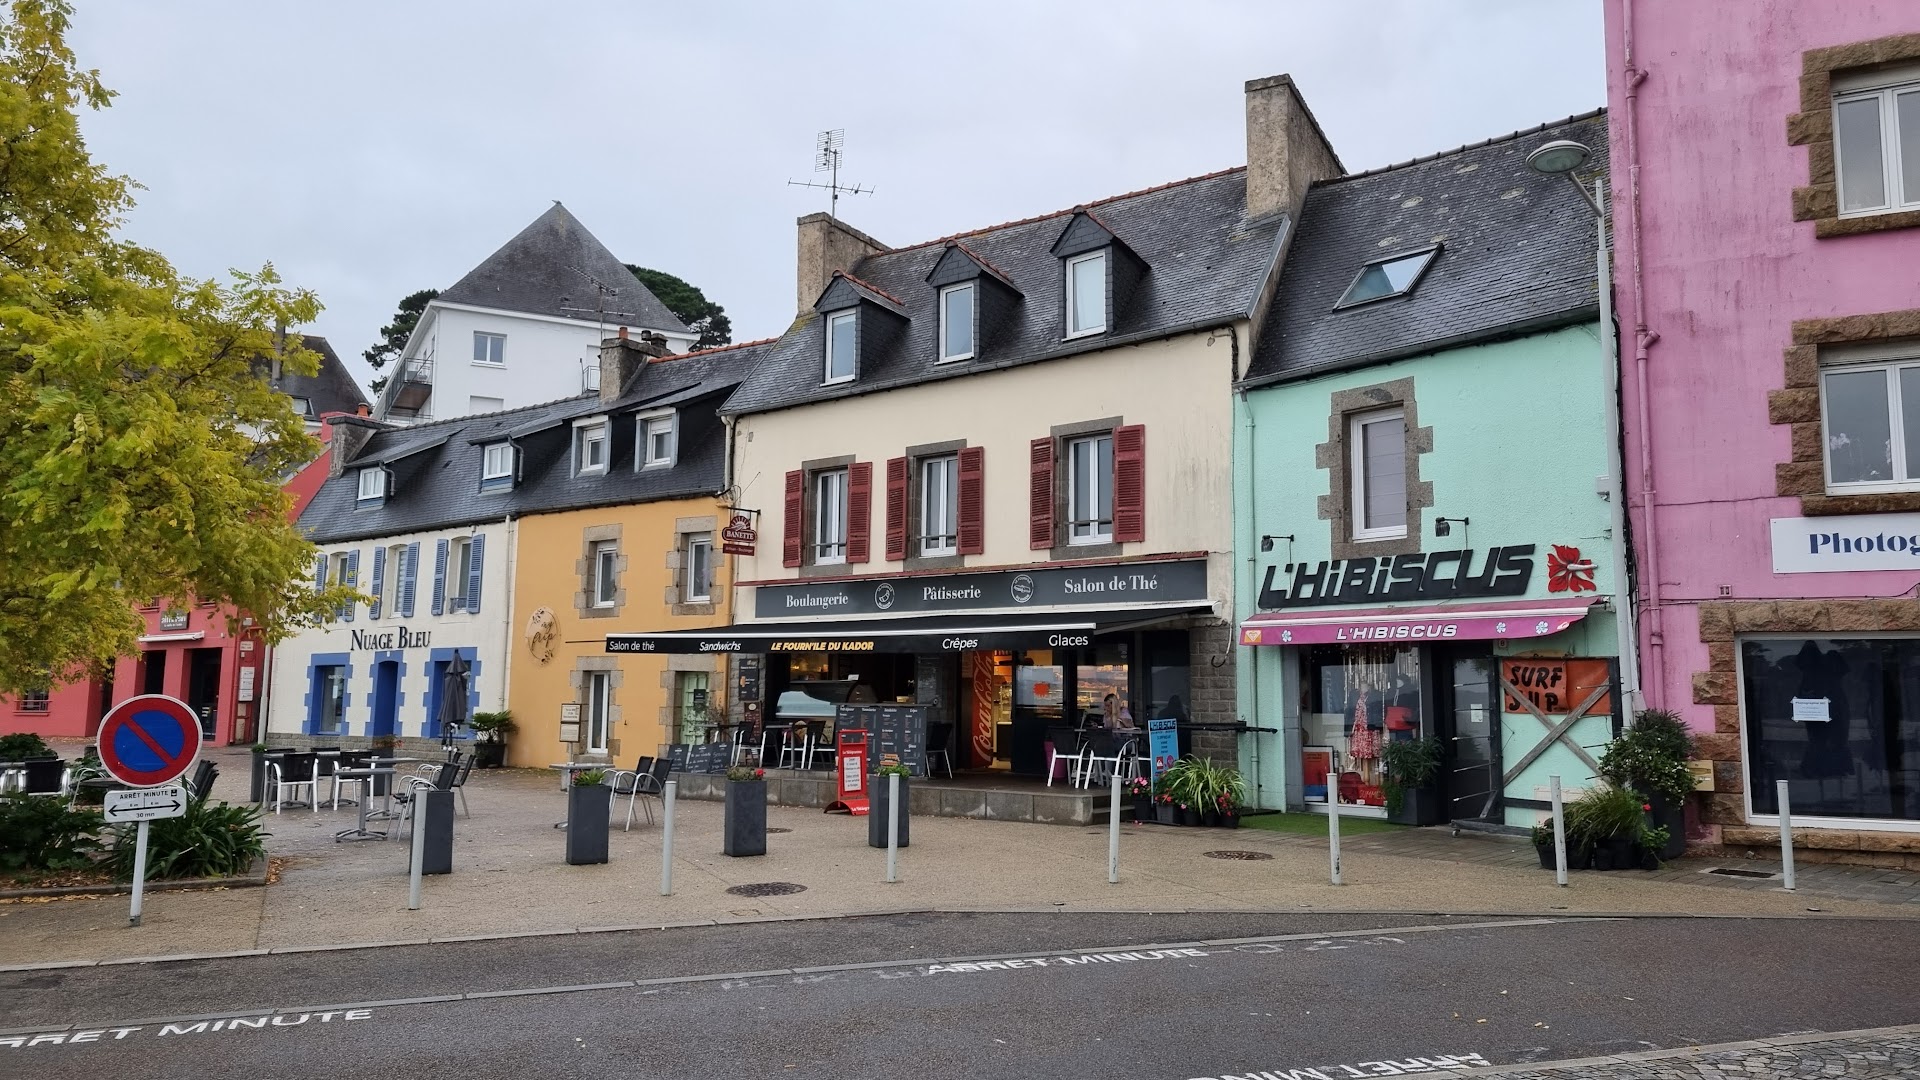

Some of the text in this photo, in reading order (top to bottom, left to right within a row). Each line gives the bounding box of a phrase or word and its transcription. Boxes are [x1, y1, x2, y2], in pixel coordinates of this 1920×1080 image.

[726, 530, 754, 540] BANETTE
[1064, 574, 1158, 594] Salon de Thé
[786, 592, 849, 609] Boulangerie
[922, 585, 982, 601] Pâtisserie
[1336, 624, 1459, 641] L'HIBISCUS
[609, 641, 655, 651] Salon de thé
[699, 640, 742, 651] Sandwichs
[770, 642, 782, 651] LE
[827, 641, 841, 651] DU
[841, 641, 875, 651] KADOR
[942, 637, 979, 651] Crêpes
[1048, 634, 1089, 647] Glaces
[1510, 666, 1563, 690] SURF
[119, 790, 169, 800] ARRÊT MINUTE
[1055, 947, 1210, 965] MINUTE
[157, 1009, 373, 1037] MINUTE
